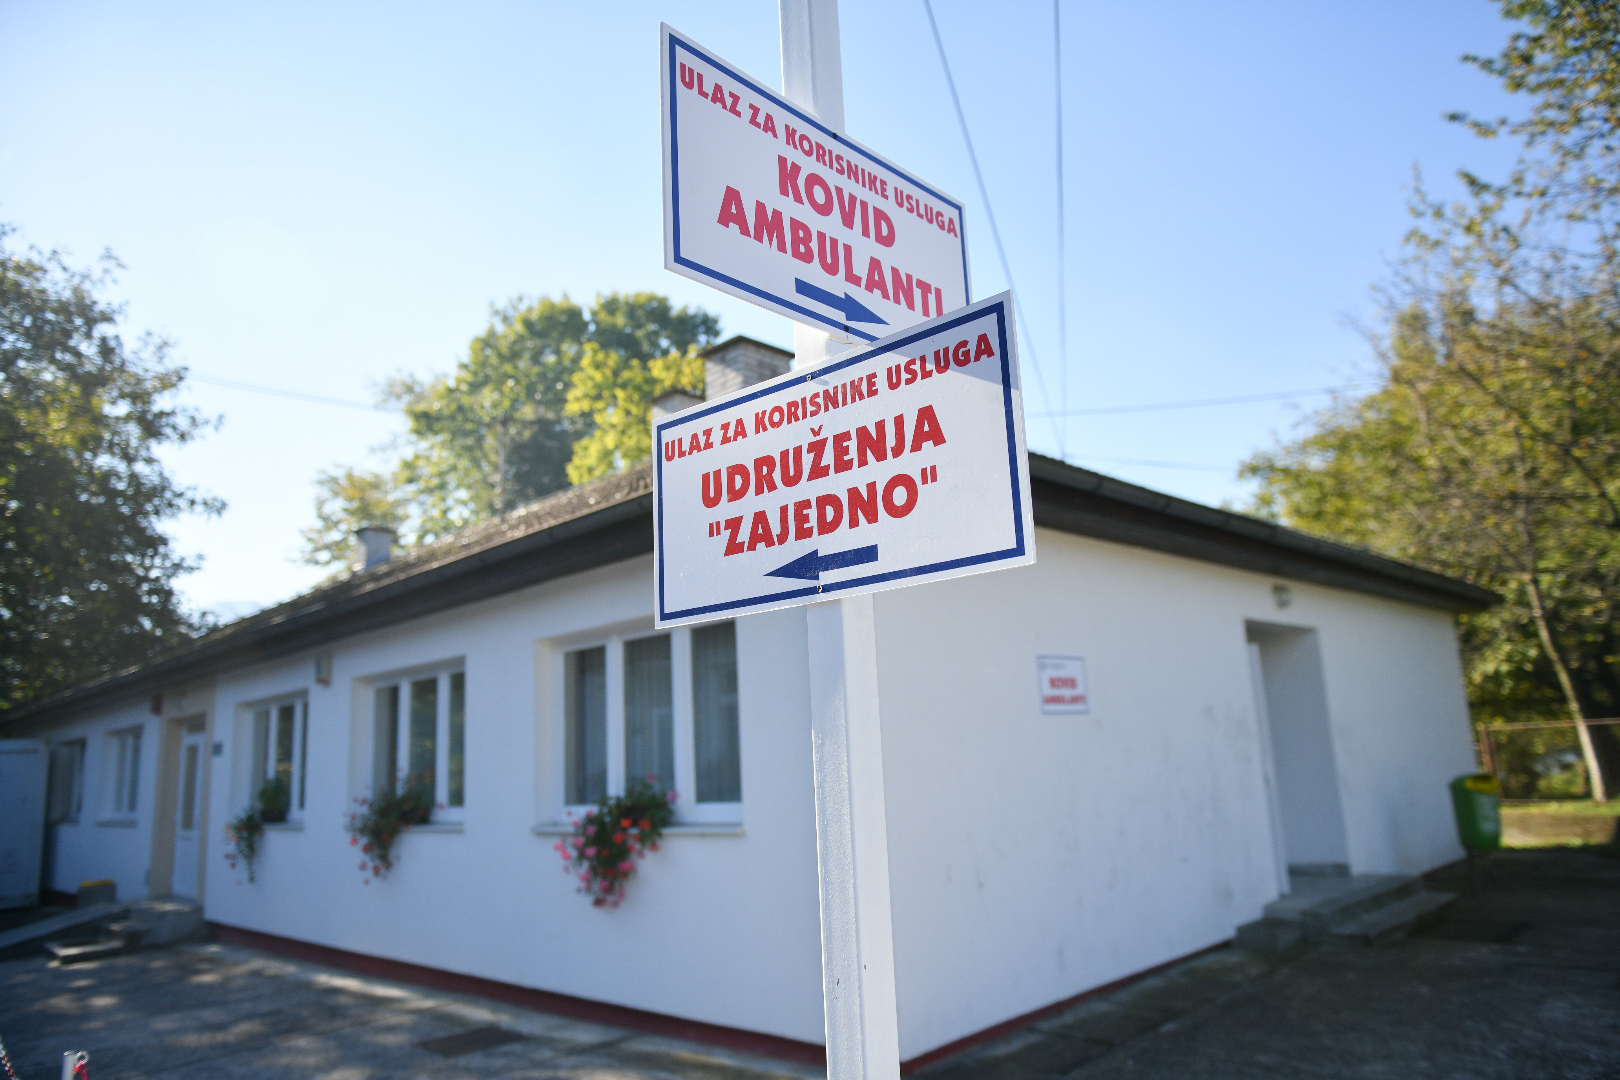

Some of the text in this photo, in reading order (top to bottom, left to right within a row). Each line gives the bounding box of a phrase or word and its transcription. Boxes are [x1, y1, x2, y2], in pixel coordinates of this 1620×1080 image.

[679, 62, 959, 239] ULAZ ZA KORISNIKE USLUGA
[777, 154, 897, 248] KOVID
[717, 185, 945, 318] AMBULANTI
[665, 332, 995, 462] ULAZ ZA KORISNIKE USLUGA
[701, 404, 947, 508] UDRUŽENJA
[708, 465, 939, 557] "ZAJEDNO"
